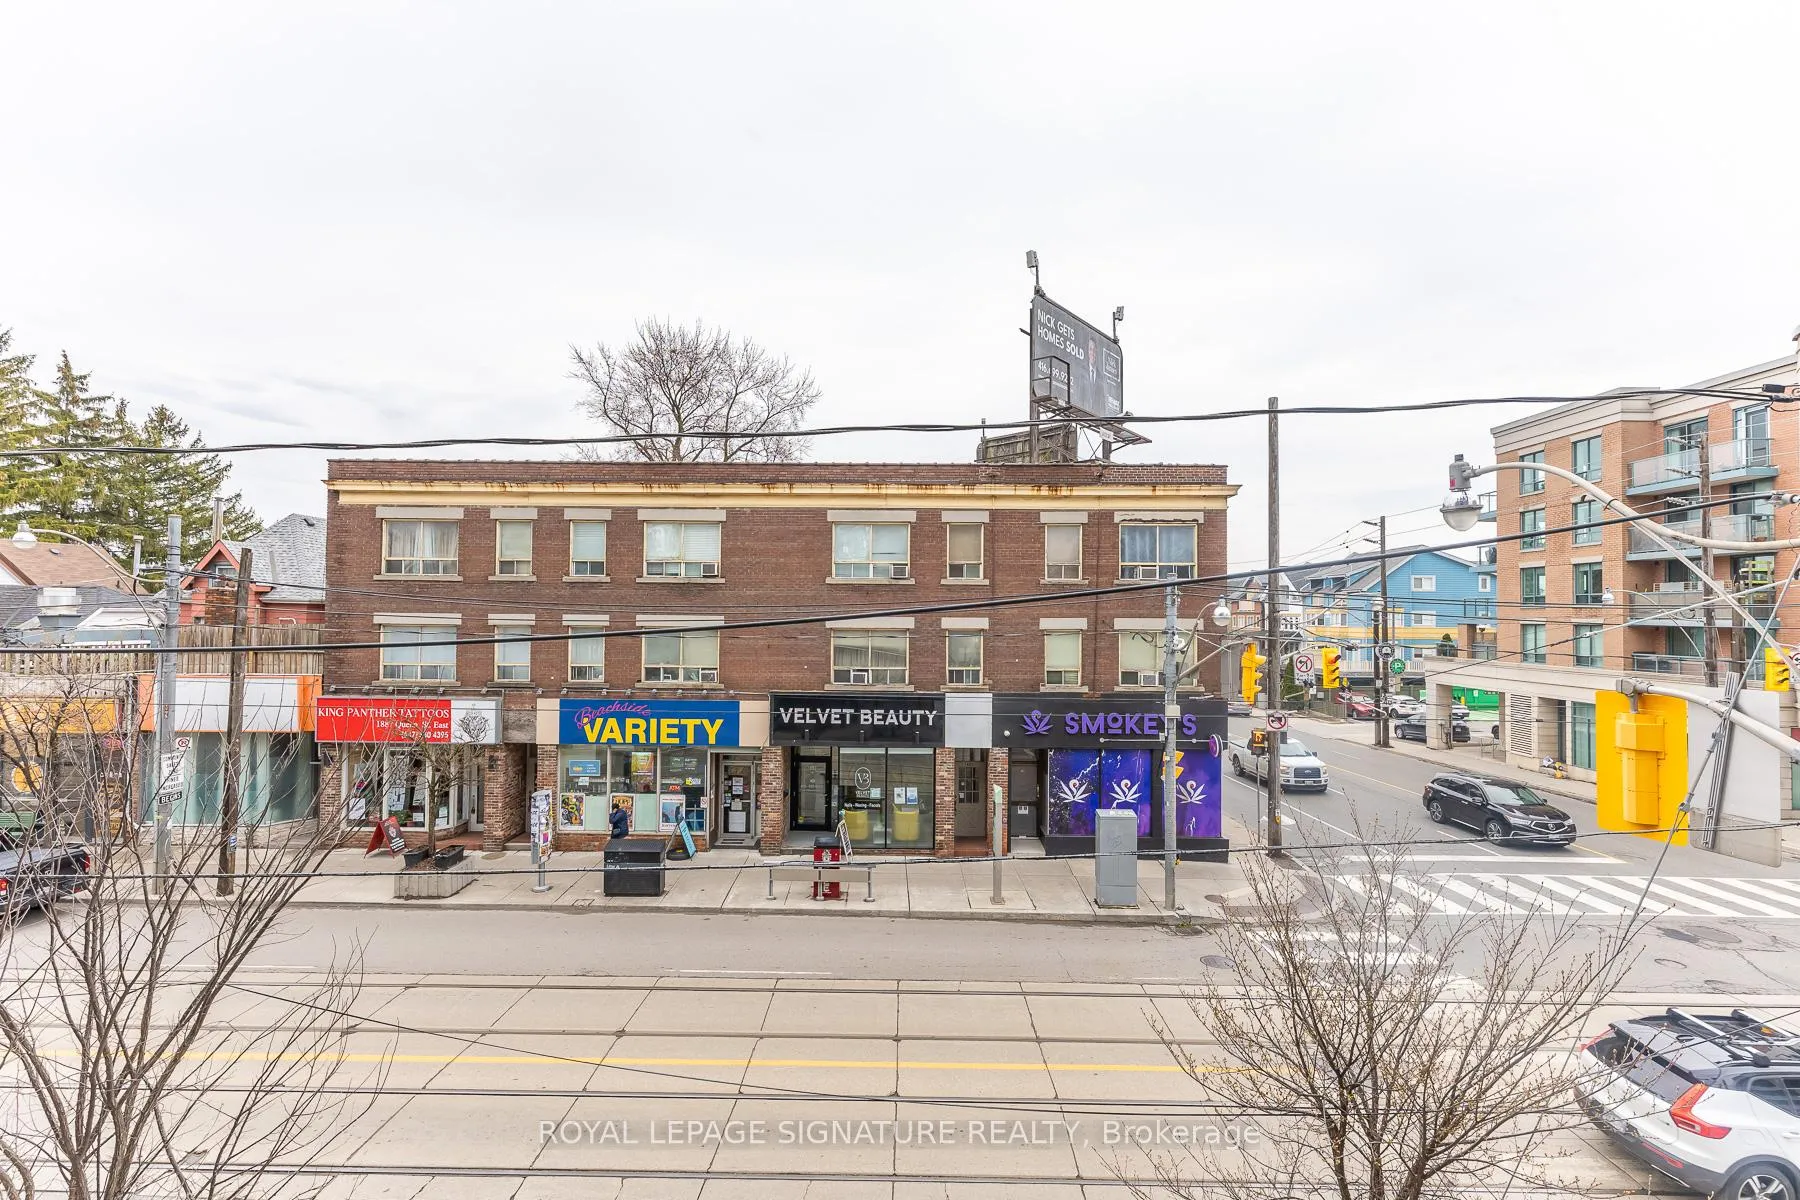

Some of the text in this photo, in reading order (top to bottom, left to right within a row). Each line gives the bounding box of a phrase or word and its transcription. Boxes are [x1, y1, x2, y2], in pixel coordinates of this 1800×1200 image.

[1037, 309, 1075, 341] NICK GETS
[1037, 324, 1085, 360] HOMES SOLD
[1038, 361, 1074, 386] 416.99.922
[317, 707, 344, 718] KING
[346, 708, 397, 719] PANTHER
[433, 720, 449, 729] East
[574, 701, 652, 729] Beachside
[779, 707, 938, 726] VELVET BEAUTY
[583, 717, 724, 745] VARIETY
